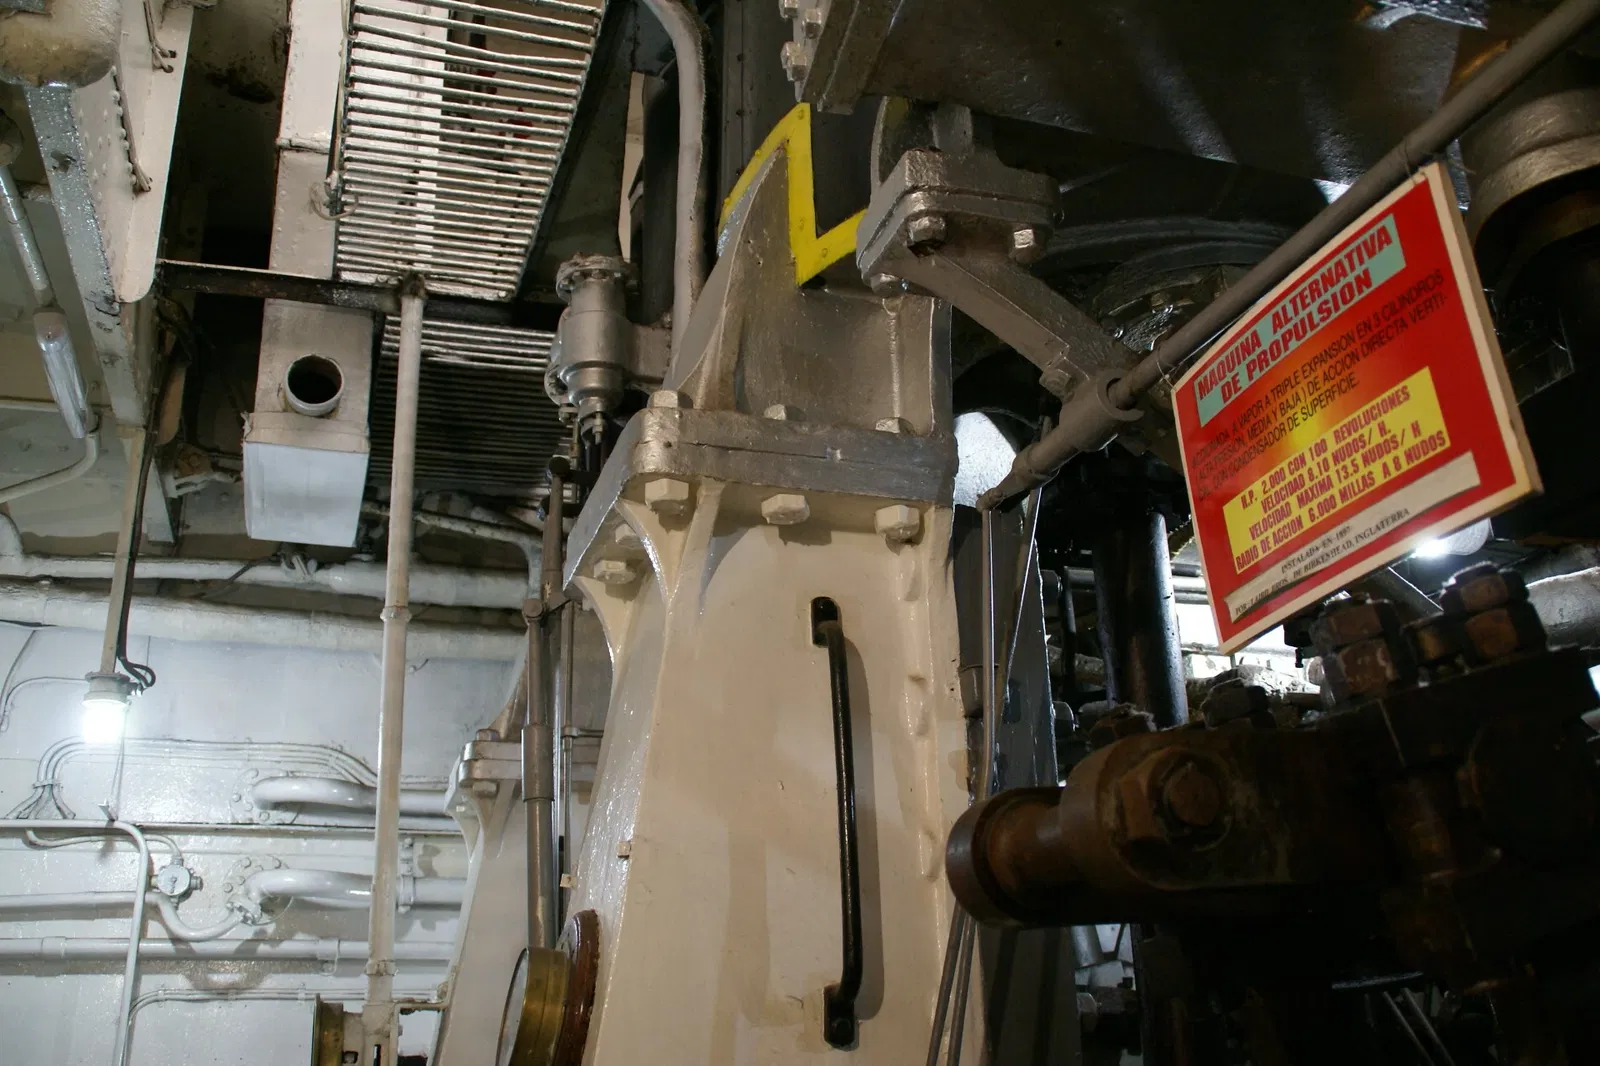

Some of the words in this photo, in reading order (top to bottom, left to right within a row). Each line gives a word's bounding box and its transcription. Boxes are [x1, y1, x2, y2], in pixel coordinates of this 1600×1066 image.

[1196, 327, 1262, 401] MAQUINA
[1268, 220, 1393, 336] ALTERNATIVA
[1219, 371, 1242, 405] DE
[1244, 266, 1373, 383] PROPULSION
[1236, 397, 1264, 429] VAPOR
[1264, 393, 1271, 407] A
[1270, 369, 1301, 402] TRIPLE
[1300, 327, 1357, 380] EXPANSION
[1355, 315, 1373, 339] EN
[1371, 310, 1381, 329] 3
[1381, 265, 1445, 322] CILINDROS
[1246, 411, 1272, 442] MEDIA
[1271, 407, 1279, 423] Y
[1306, 374, 1321, 397] DE
[1320, 346, 1360, 386] ACCION
[1359, 313, 1409, 359] DIRECTA
[1260, 465, 1287, 496] 2.000
[1286, 451, 1306, 477] CON
[1308, 436, 1328, 462] 100
[1332, 382, 1411, 447] REVOLUCIONES
[1227, 420, 1287, 478] CONDENSADOR
[1285, 410, 1300, 432] DE
[1234, 543, 1259, 571] RADIO
[1259, 535, 1272, 554] DE
[1271, 513, 1304, 547] ACCION
[1307, 492, 1338, 523] 6.000
[1337, 469, 1376, 505] MILLAS
[1380, 460, 1391, 480] A
[1391, 454, 1402, 473] 8
[1403, 428, 1447, 466] NUDOS
[1248, 500, 1292, 542] VELOCIDAD
[1295, 473, 1334, 510] MAXIMA
[1334, 456, 1360, 484] 13.5
[1409, 419, 1422, 439] H
[1260, 471, 1306, 515] VELOCIDAD
[1306, 455, 1331, 483] 8.10
[1376, 416, 1391, 439] H.
[1280, 543, 1319, 574] INSTALADA
[1354, 506, 1410, 544] INGLATERRA
